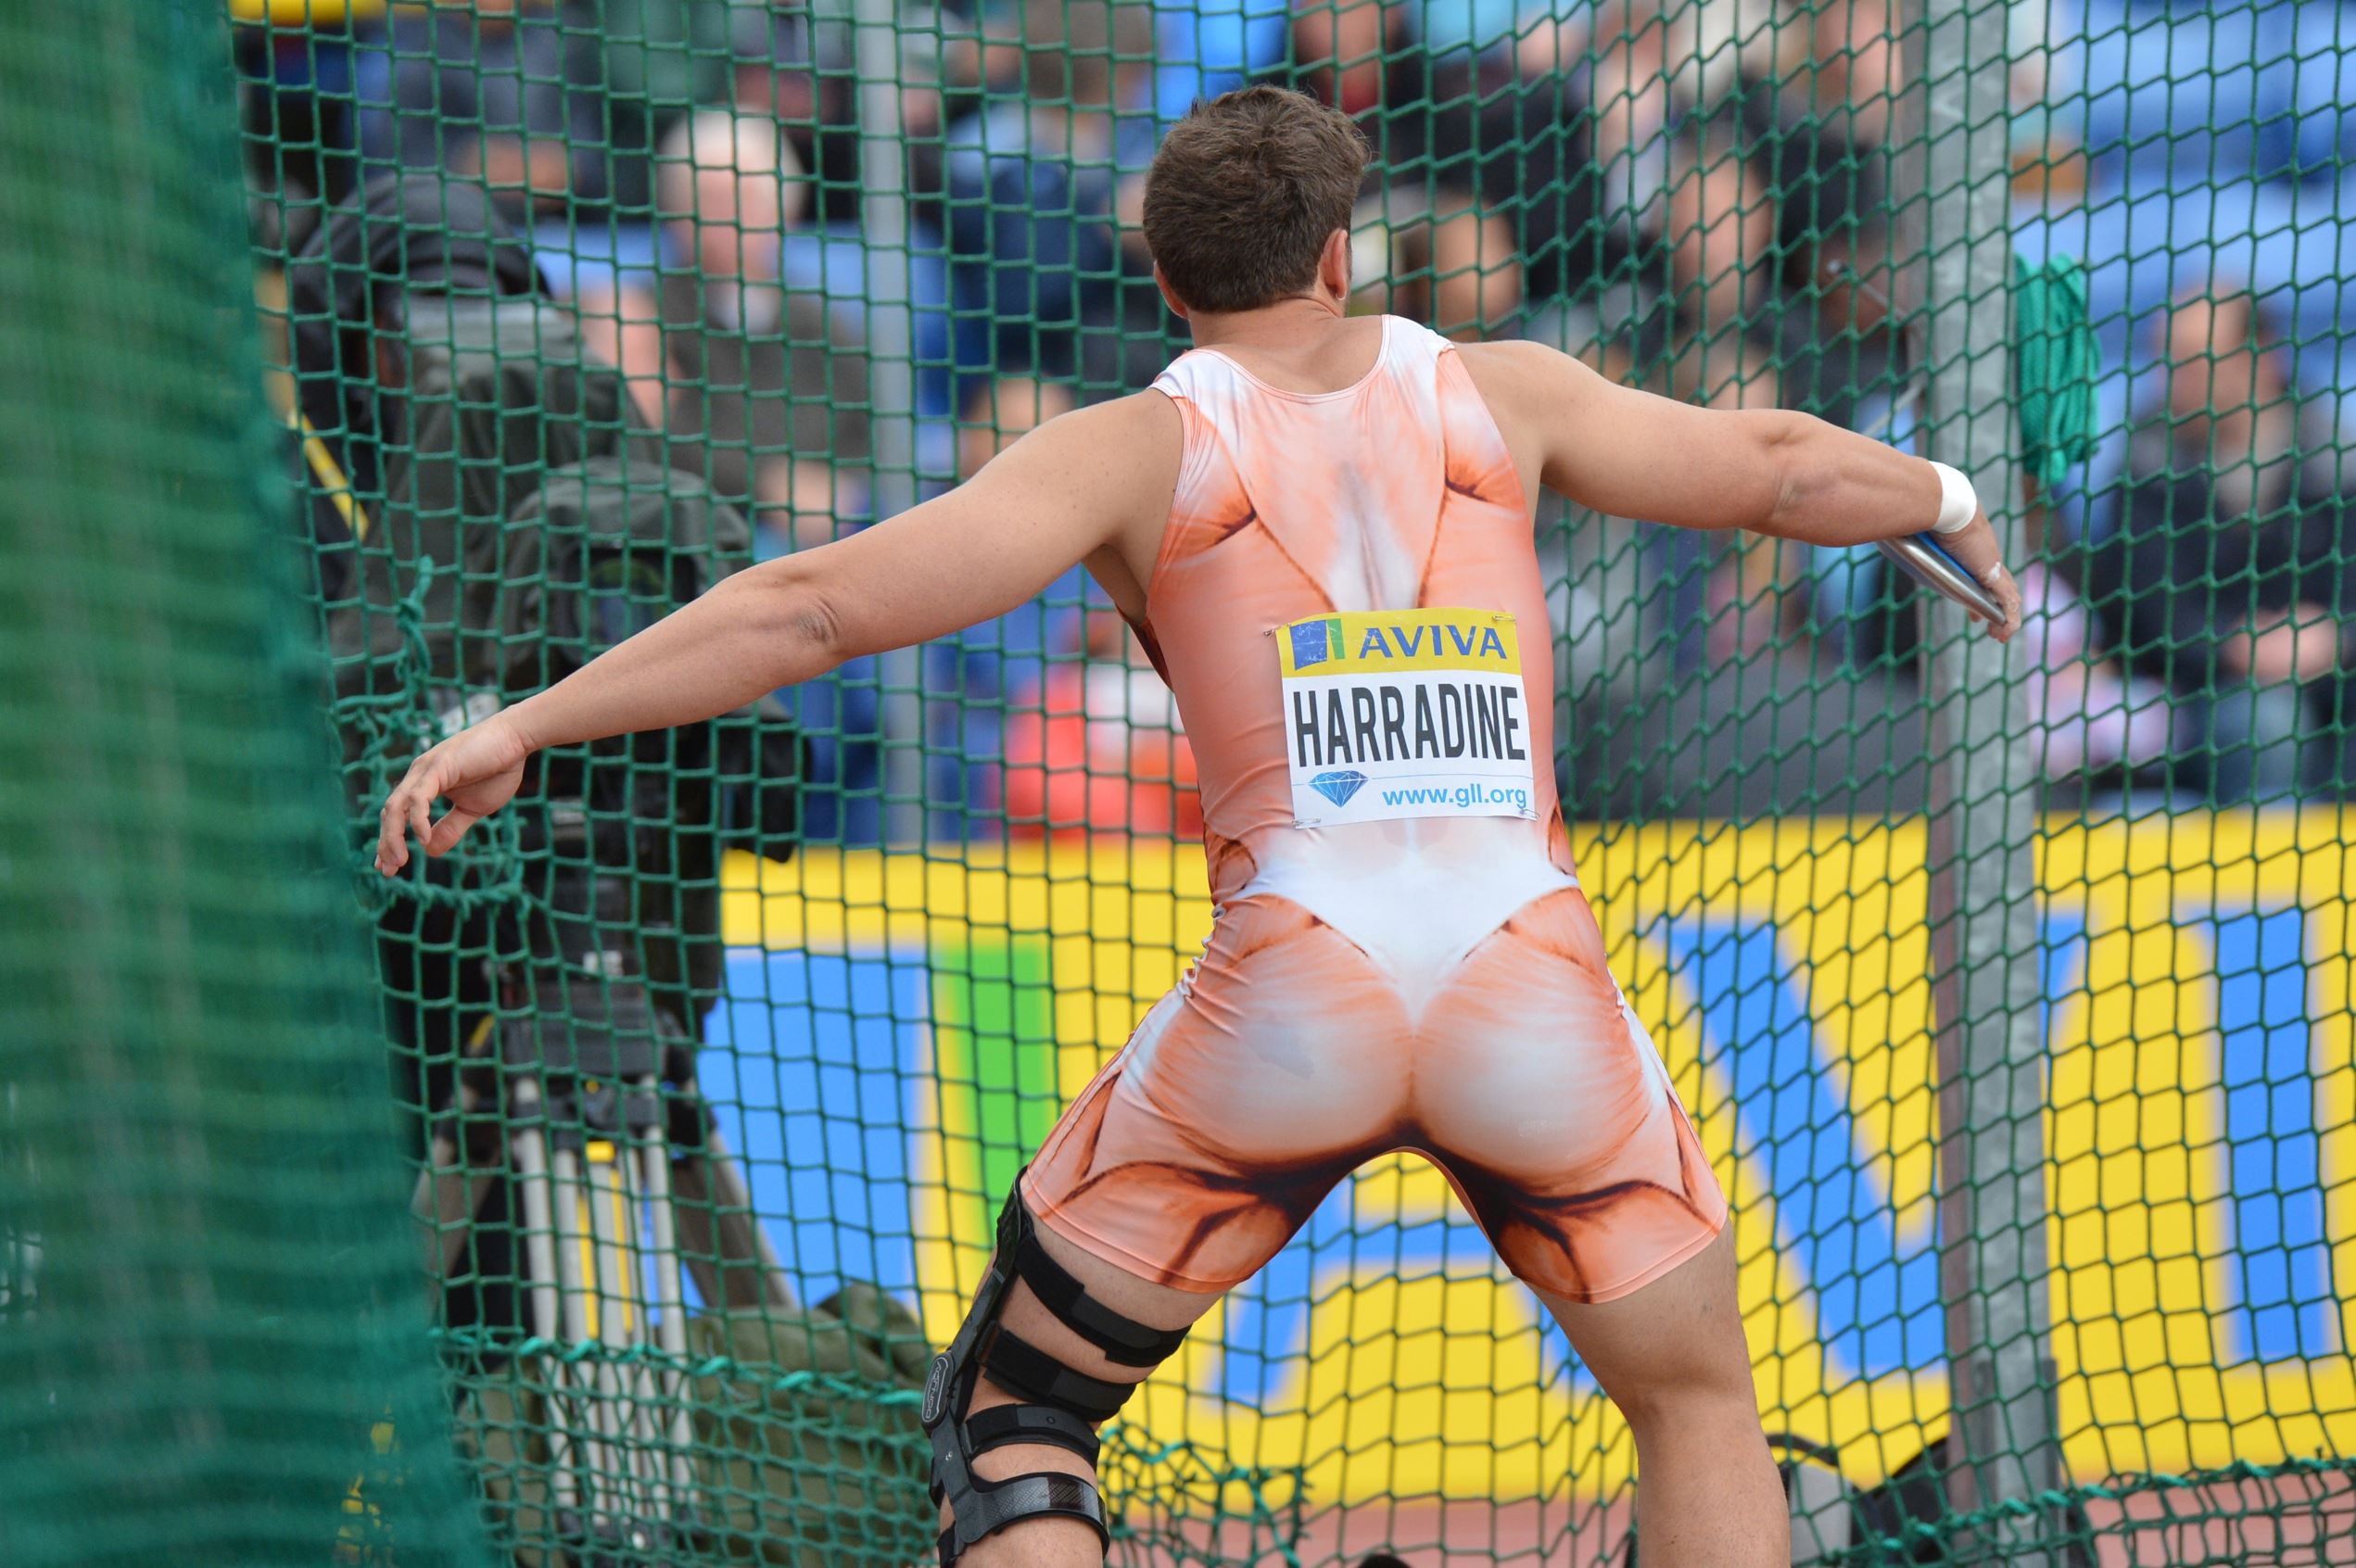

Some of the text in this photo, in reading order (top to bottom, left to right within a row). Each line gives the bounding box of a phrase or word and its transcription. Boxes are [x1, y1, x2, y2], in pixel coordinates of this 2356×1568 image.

[1359, 625, 1507, 659] AVIVA
[1293, 683, 1526, 767] HARRADINE
[1382, 783, 1527, 809] www.gll.org
